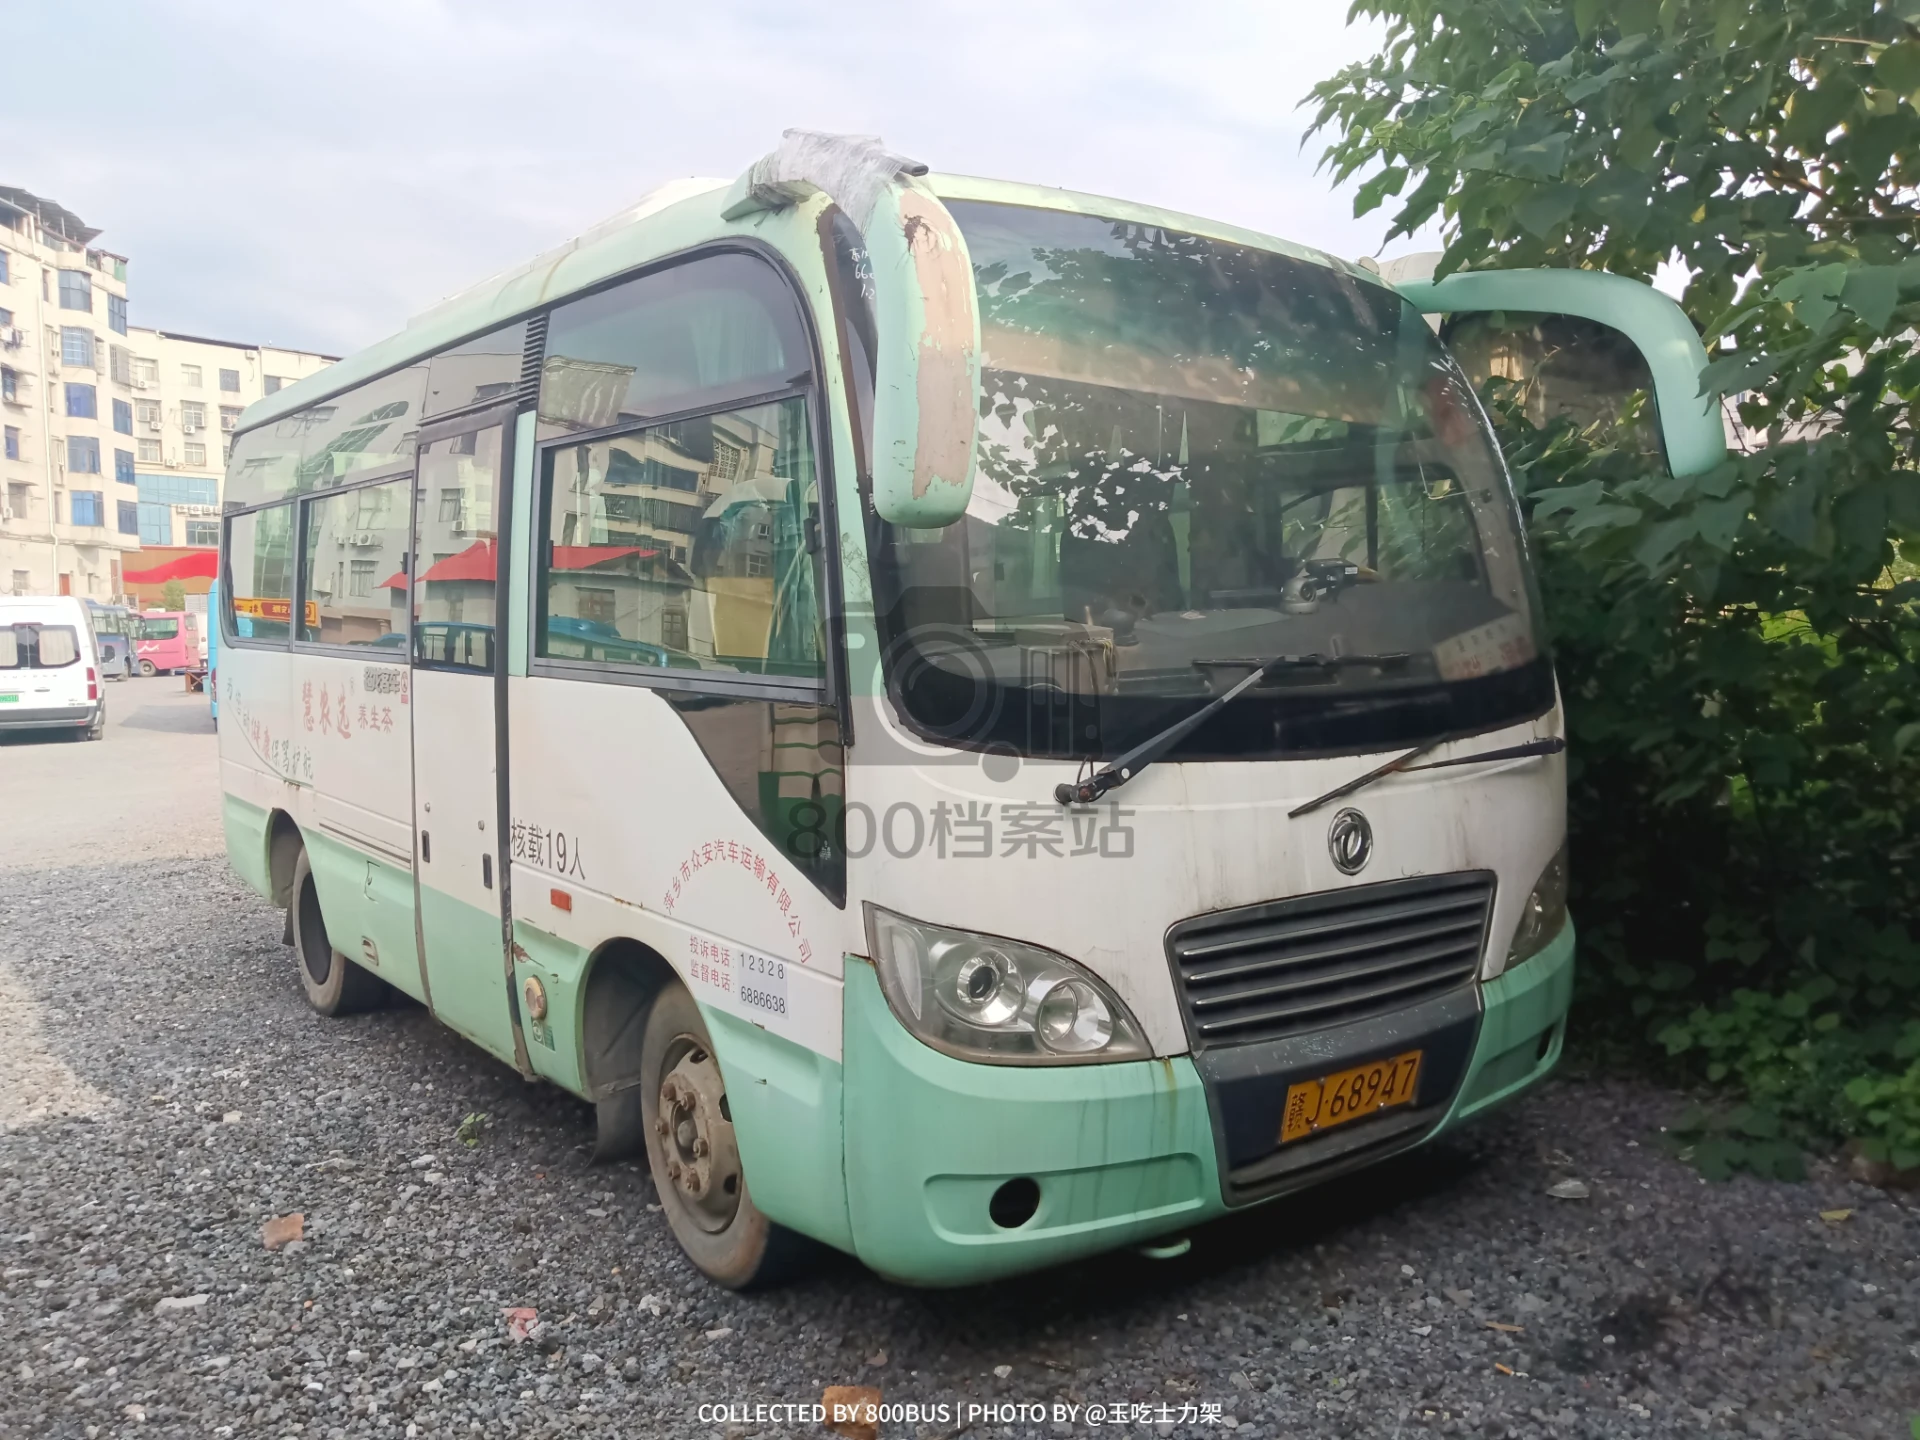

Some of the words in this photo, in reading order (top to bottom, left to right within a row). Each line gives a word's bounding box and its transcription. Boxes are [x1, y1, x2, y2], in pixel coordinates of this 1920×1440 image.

[357, 703, 393, 734] 养生茶
[511, 817, 586, 880] 核载19人
[663, 839, 812, 963] 萍乡市众安汽车运输有限公司
[740, 952, 784, 979] 12328
[741, 986, 786, 1014] 6886638
